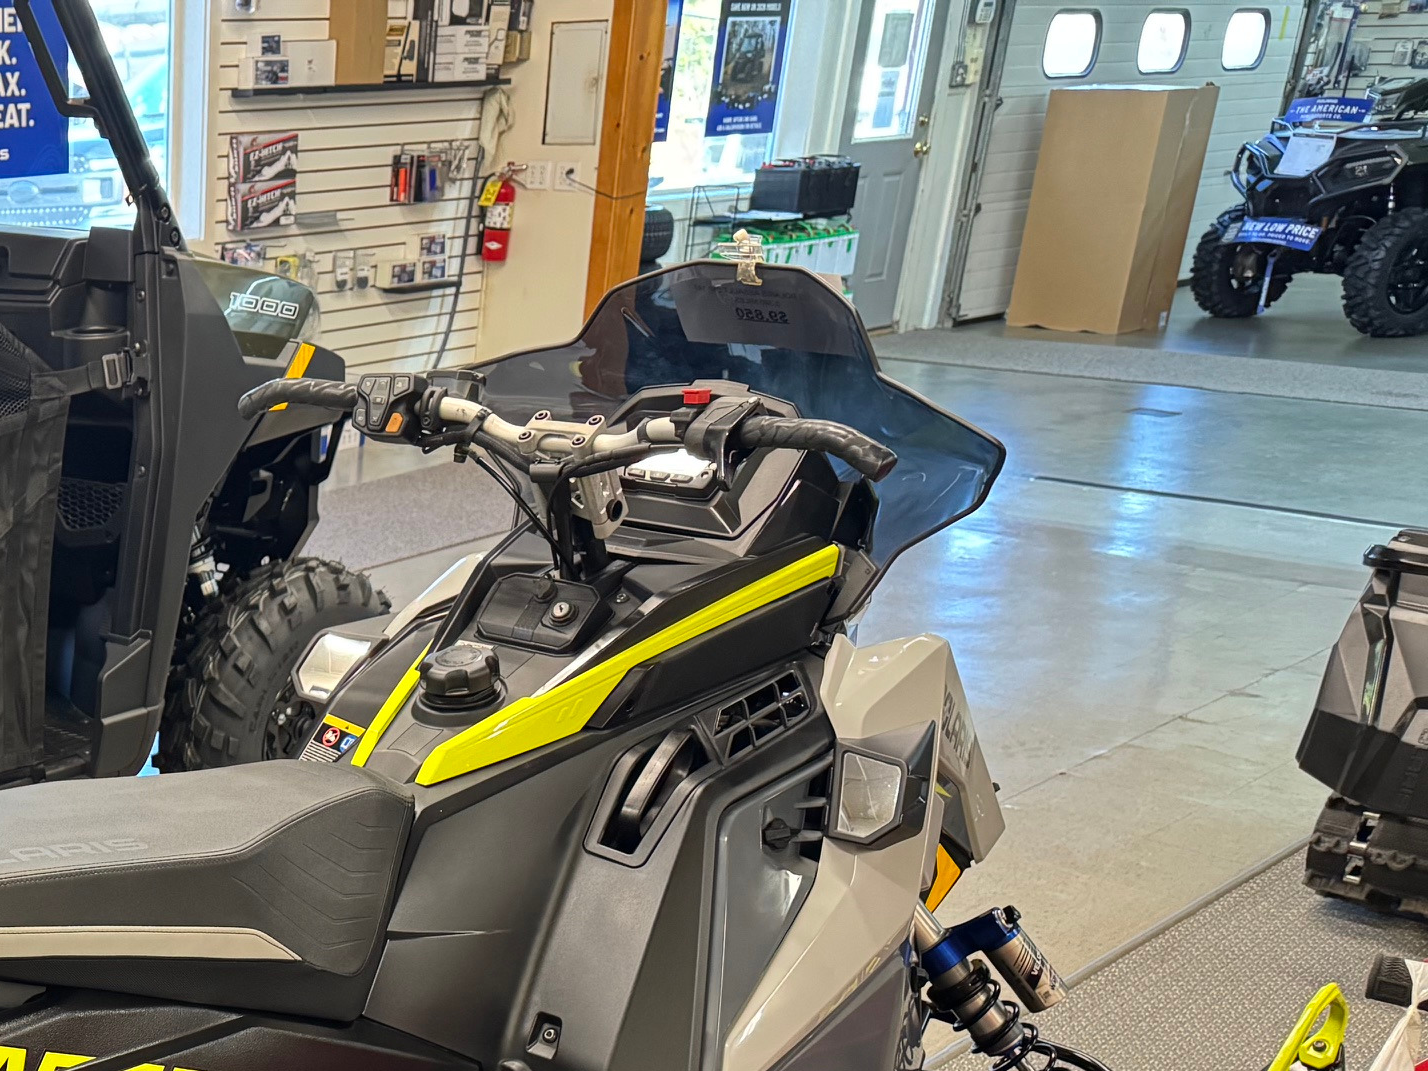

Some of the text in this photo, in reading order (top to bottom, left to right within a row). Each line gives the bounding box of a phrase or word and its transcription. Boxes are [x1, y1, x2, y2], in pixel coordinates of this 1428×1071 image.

[1296, 104, 1359, 114] THE AMERICAN
[1242, 221, 1319, 238] NEW LOW PRICE
[230, 292, 299, 319] 1000
